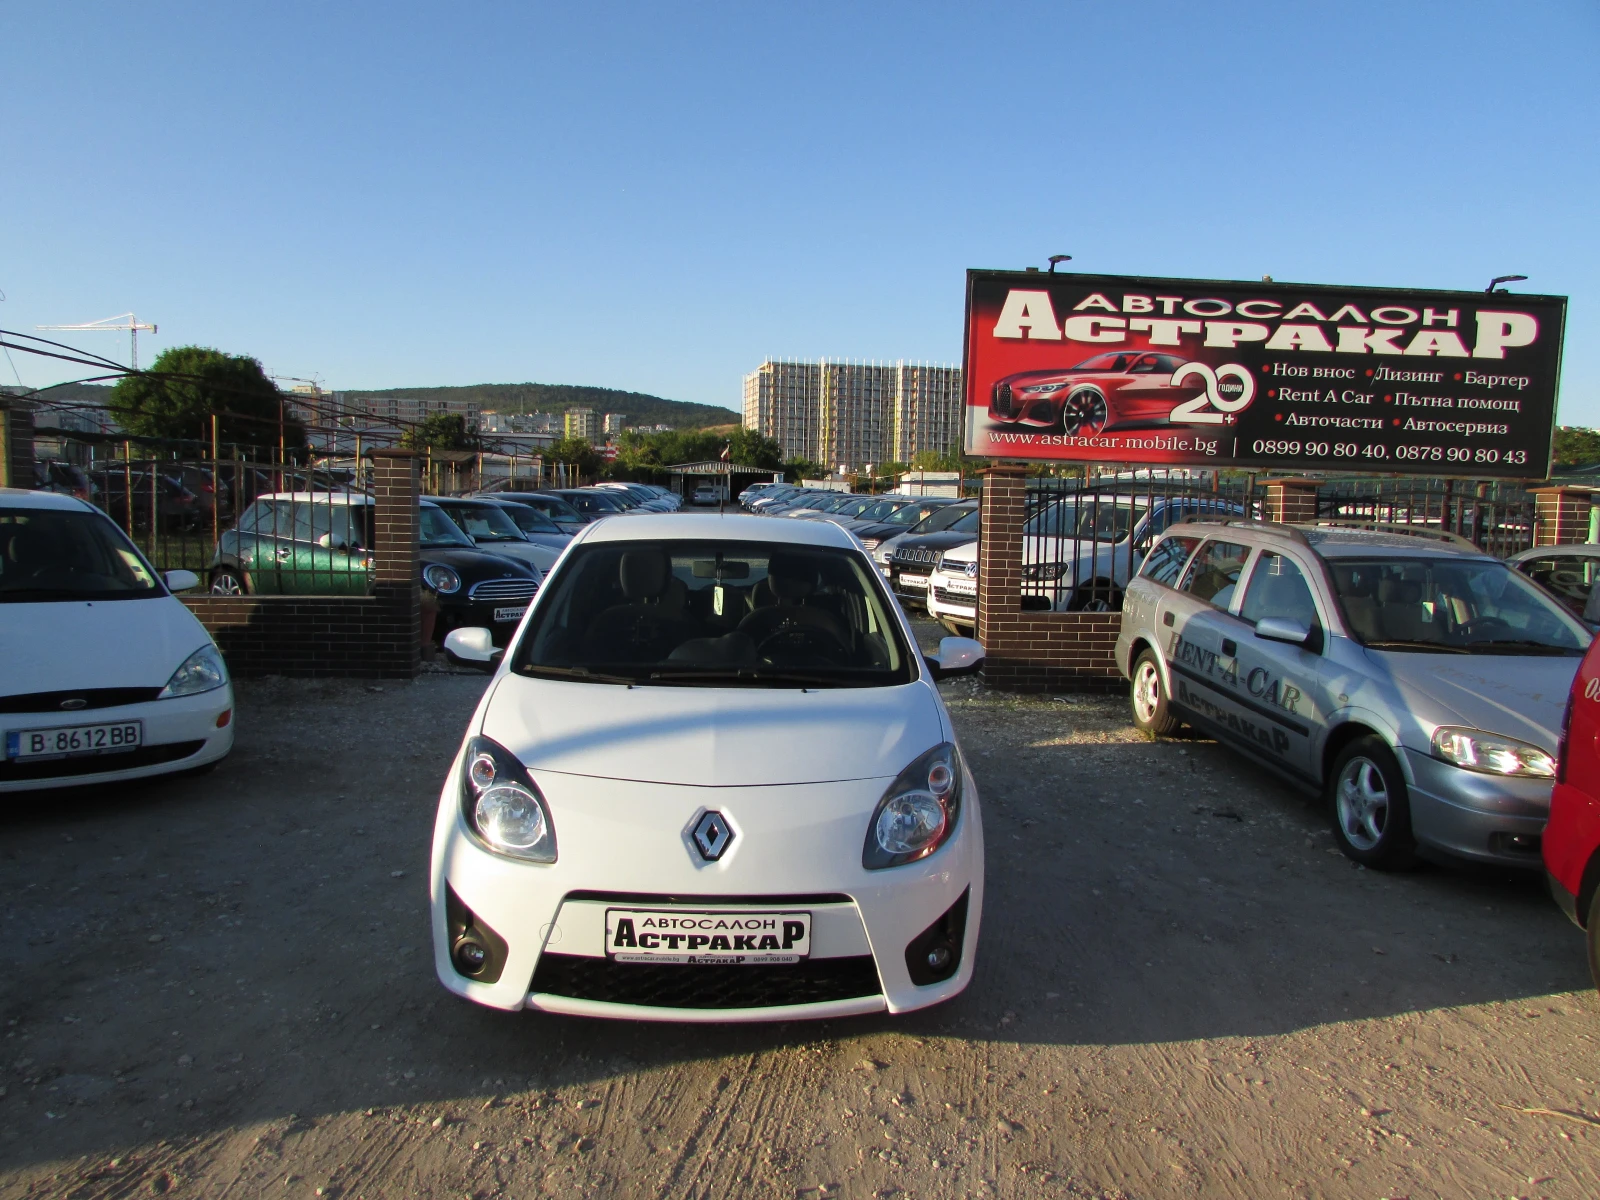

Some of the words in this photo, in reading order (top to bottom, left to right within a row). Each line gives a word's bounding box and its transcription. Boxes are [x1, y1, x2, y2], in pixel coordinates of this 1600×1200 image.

[1072, 293, 1458, 327] АВТОСАЛОН
[993, 289, 1538, 359] АСТРАКАР
[1272, 362, 1308, 377] Нов
[1312, 367, 1355, 379] внос
[1375, 367, 1443, 383] Лизинг
[1464, 371, 1529, 390] Бартер
[1278, 388, 1320, 402] Rent
[1323, 390, 1337, 403] A
[1341, 390, 1374, 404] Car
[1394, 392, 1453, 408] Пътна
[1457, 398, 1520, 413] помощ
[1284, 412, 1383, 429] Авточасти
[1403, 418, 1508, 436] Автосервиз
[989, 431, 1218, 456] www.astracar.mobile.bg
[1252, 439, 1301, 455] 0899
[1305, 441, 1329, 456] 90
[1333, 442, 1357, 457] 80
[1361, 444, 1390, 460] 40,
[1395, 445, 1442, 461] 0878
[1446, 447, 1470, 462] 90
[1474, 448, 1499, 463] 80
[1502, 450, 1526, 464] 43
[1166, 631, 1301, 715] RENT-A-CAR
[614, 917, 805, 950] АСТРАКАР
[642, 918, 776, 930] АВТОСАЛОН
